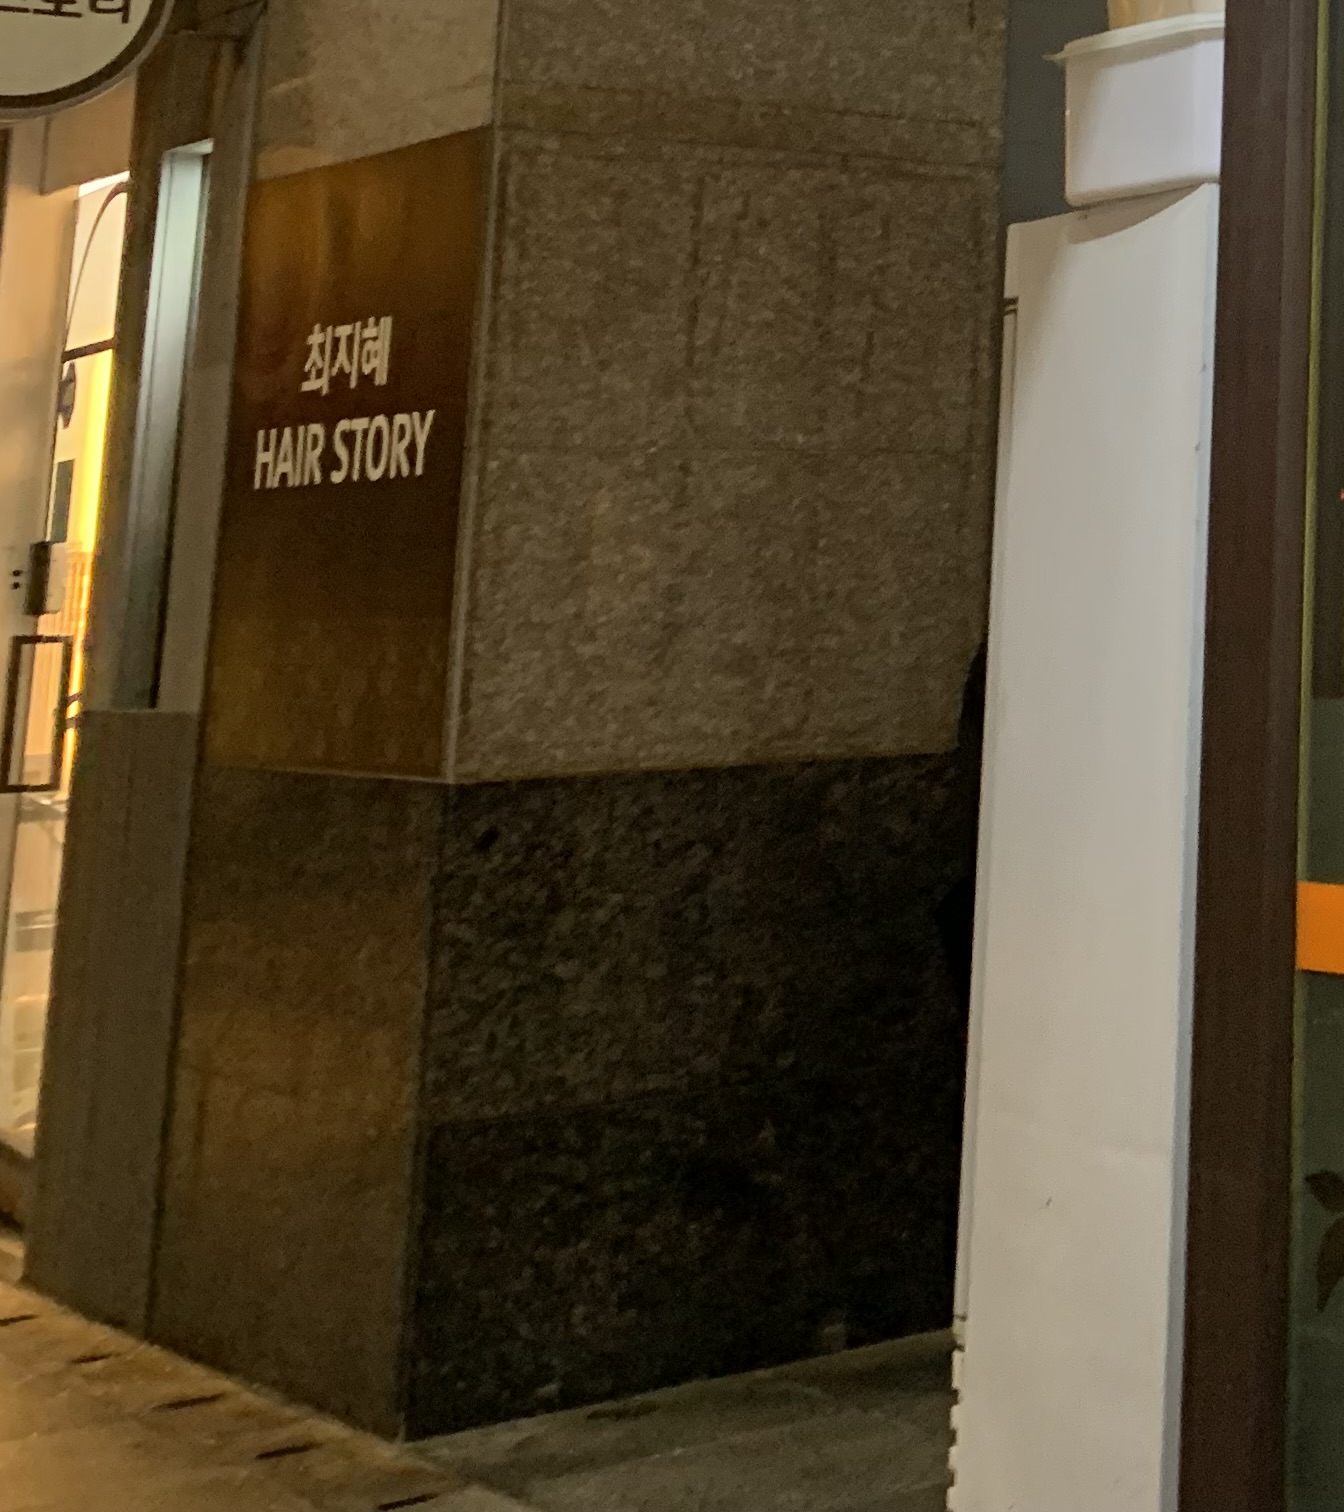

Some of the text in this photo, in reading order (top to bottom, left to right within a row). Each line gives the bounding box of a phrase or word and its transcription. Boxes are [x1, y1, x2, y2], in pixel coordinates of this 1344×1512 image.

[301, 317, 392, 397] 최지혜
[254, 409, 436, 490] HAIR STORY
